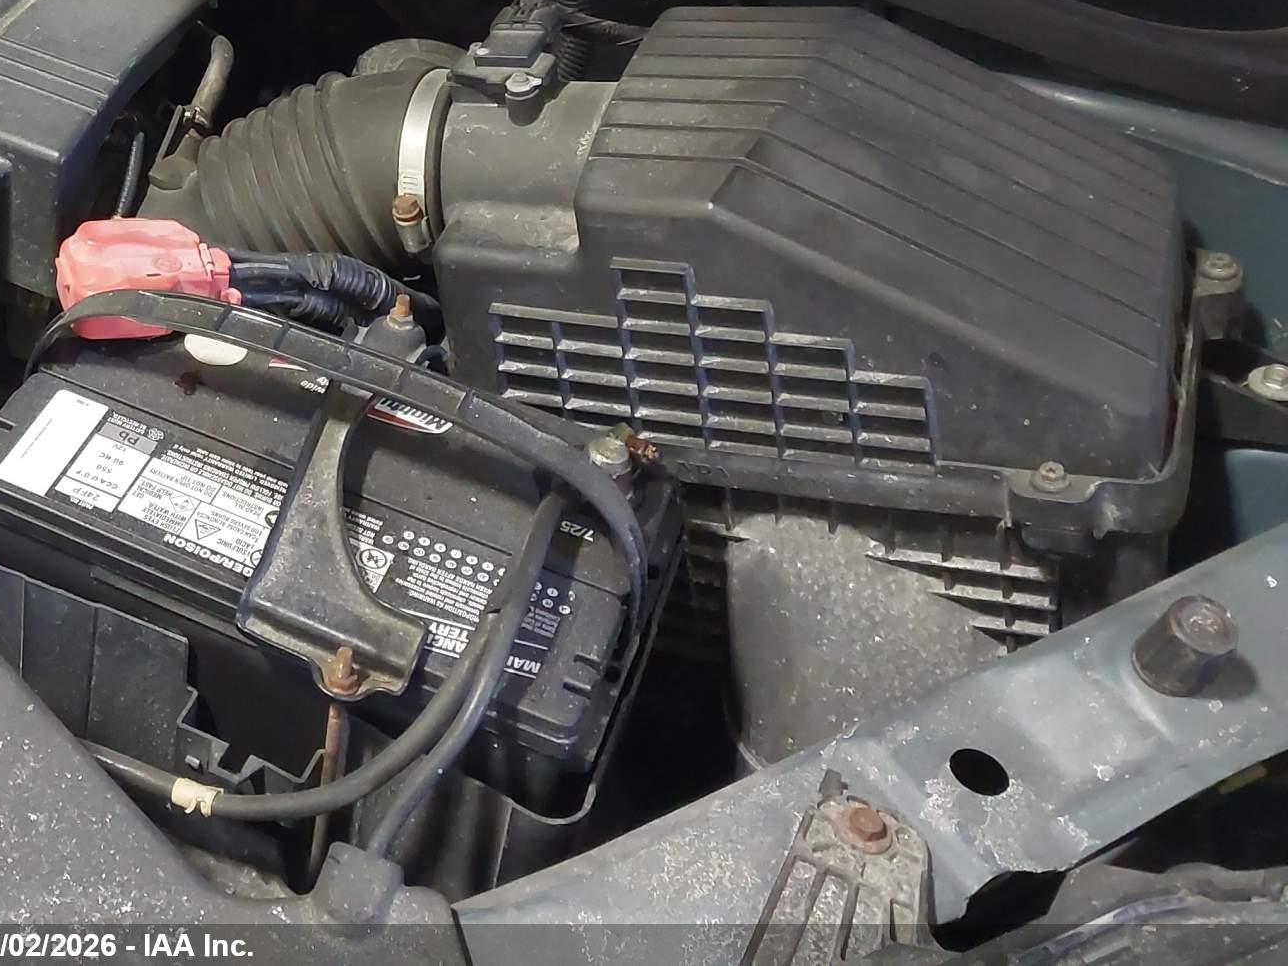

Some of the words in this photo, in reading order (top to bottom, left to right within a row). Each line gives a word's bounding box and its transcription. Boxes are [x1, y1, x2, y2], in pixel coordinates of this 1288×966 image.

[117, 429, 140, 445] Pb
[136, 485, 162, 500] MEDICAL
[559, 518, 596, 542] 7/25
[163, 533, 254, 577] GER/POISON
